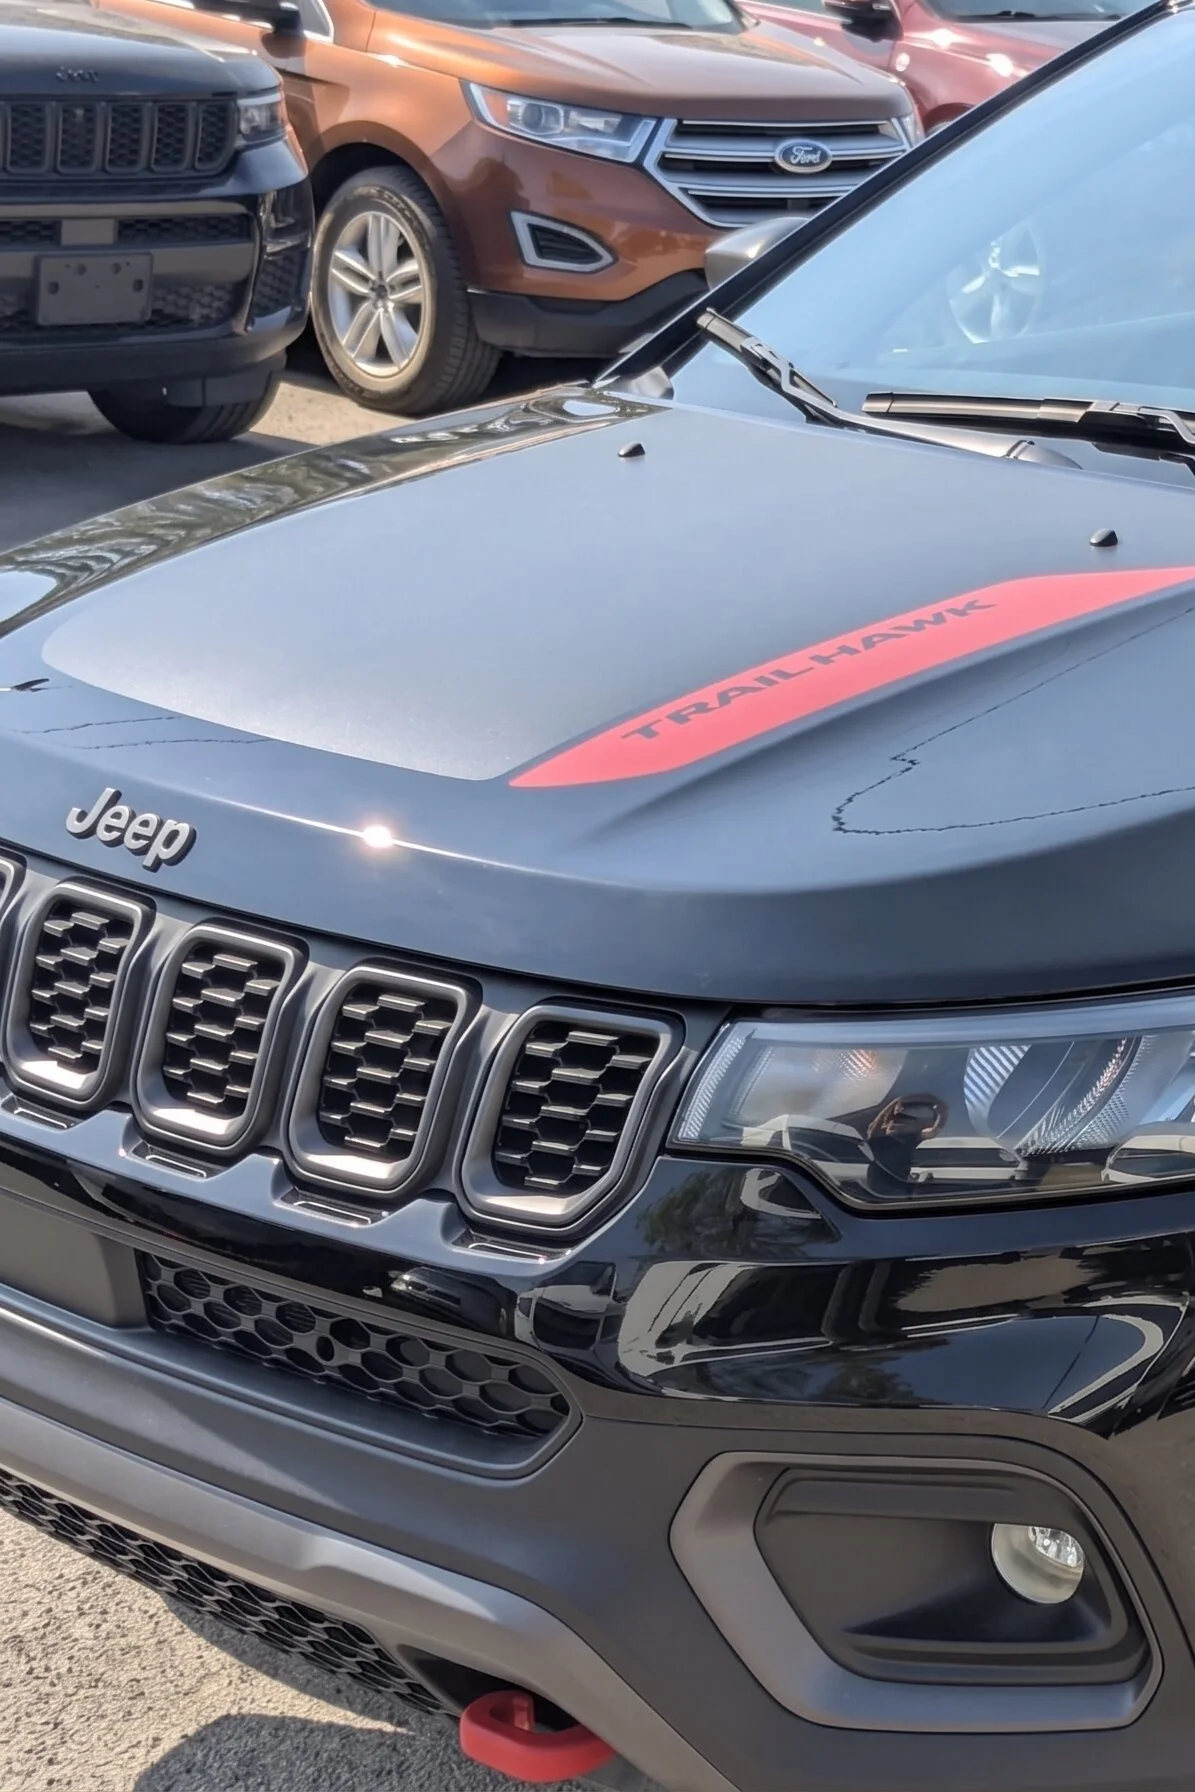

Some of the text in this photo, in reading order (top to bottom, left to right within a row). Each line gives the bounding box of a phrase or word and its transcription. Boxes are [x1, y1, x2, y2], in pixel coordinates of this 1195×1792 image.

[790, 145, 822, 165] Ford
[620, 599, 998, 740] TRAILHAWK
[65, 787, 198, 873] Jeep
